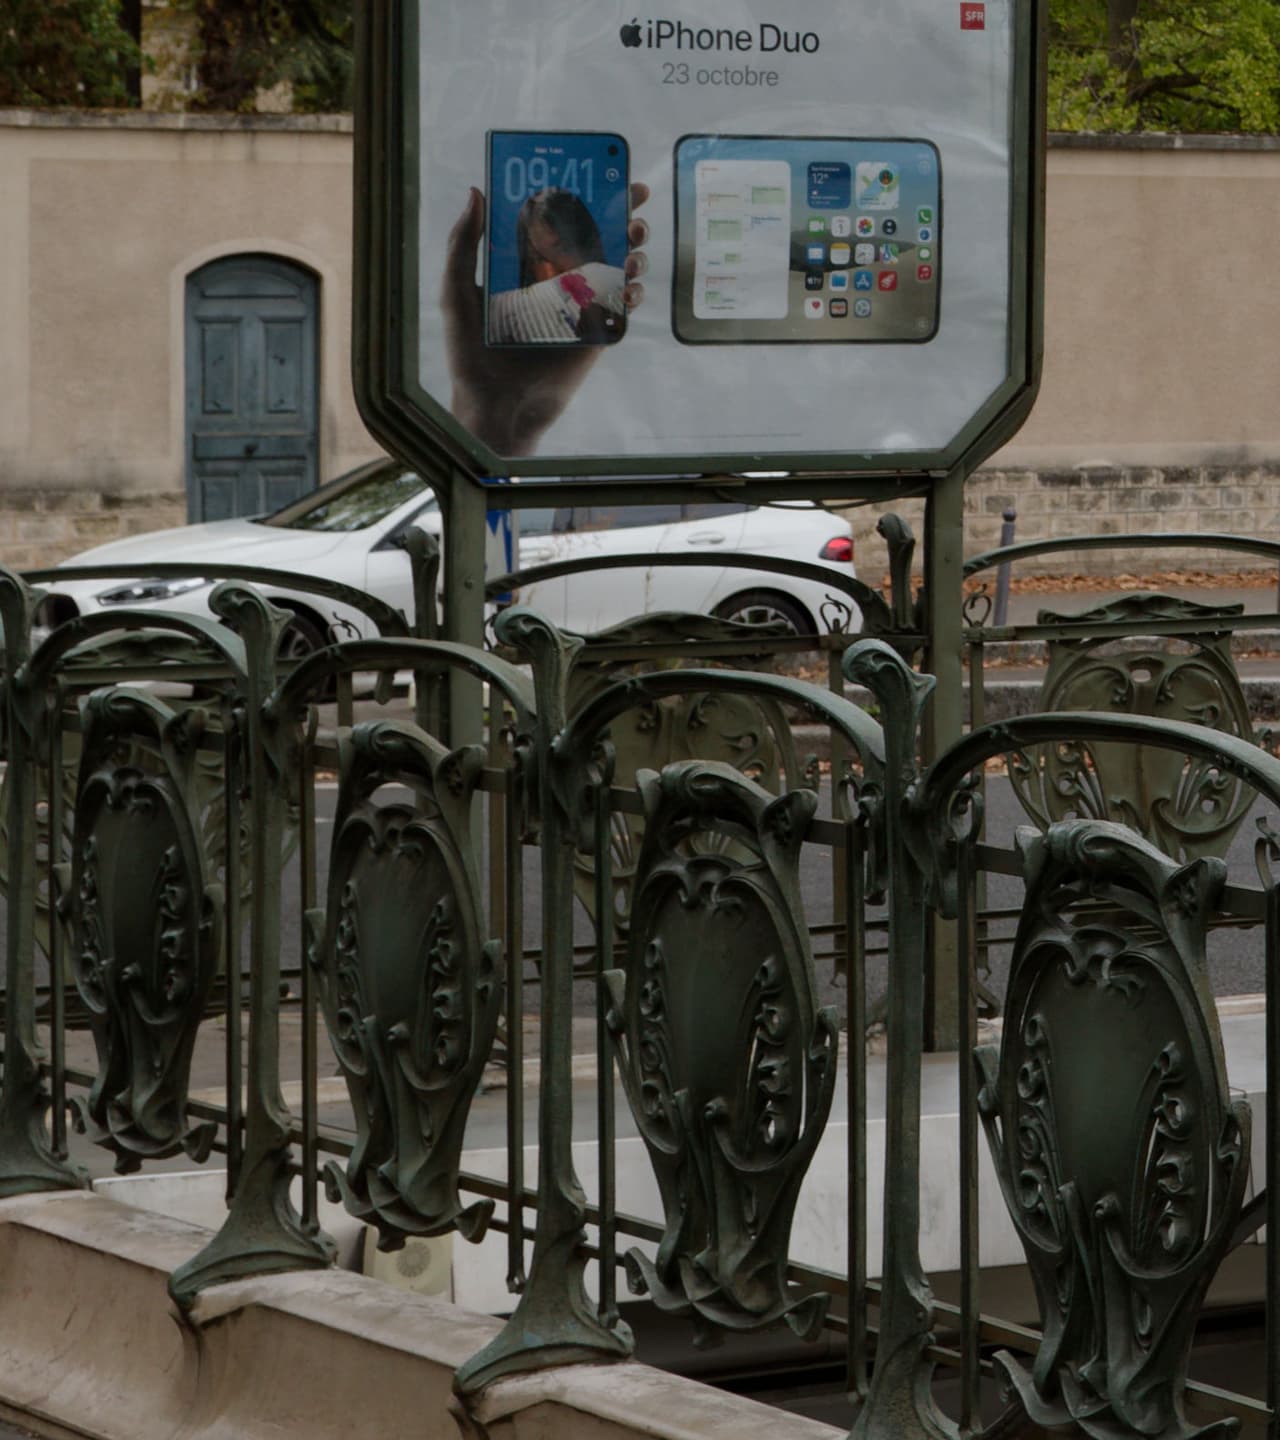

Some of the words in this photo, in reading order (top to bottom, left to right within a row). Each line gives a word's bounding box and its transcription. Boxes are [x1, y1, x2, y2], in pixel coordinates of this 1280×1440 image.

[965, 10, 984, 22] SFR
[646, 19, 752, 52] iPhone
[759, 23, 820, 53] Duo
[662, 62, 690, 85] 23
[695, 65, 779, 87] octobre
